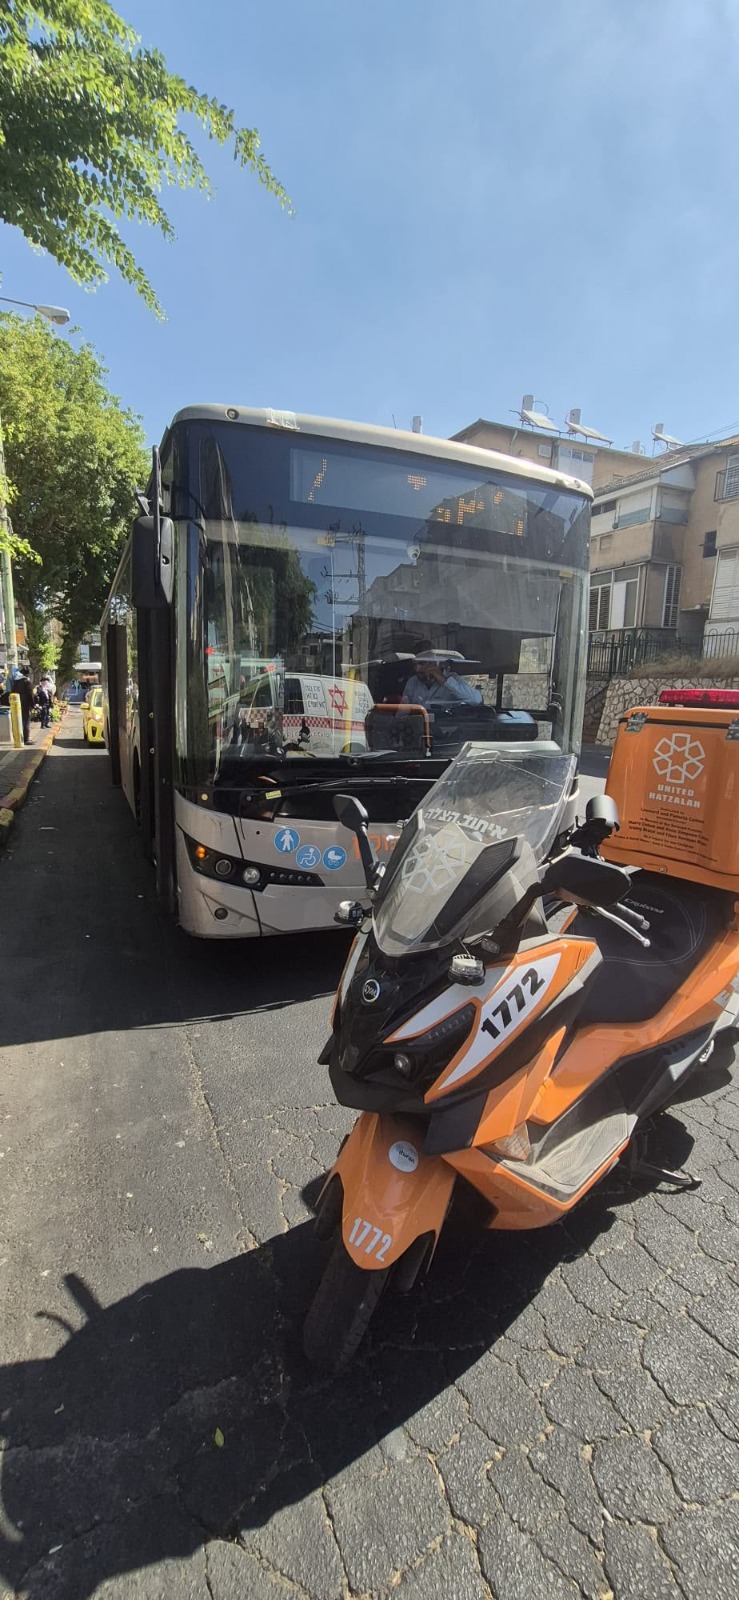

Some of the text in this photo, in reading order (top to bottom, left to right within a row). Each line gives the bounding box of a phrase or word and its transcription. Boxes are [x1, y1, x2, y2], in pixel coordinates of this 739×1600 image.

[649, 791, 701, 808] HATZALAH
[657, 783, 695, 797] UNITED
[424, 807, 508, 839] איחוד הצלה
[480, 967, 546, 1039] 1772
[348, 1217, 392, 1262] 1772
